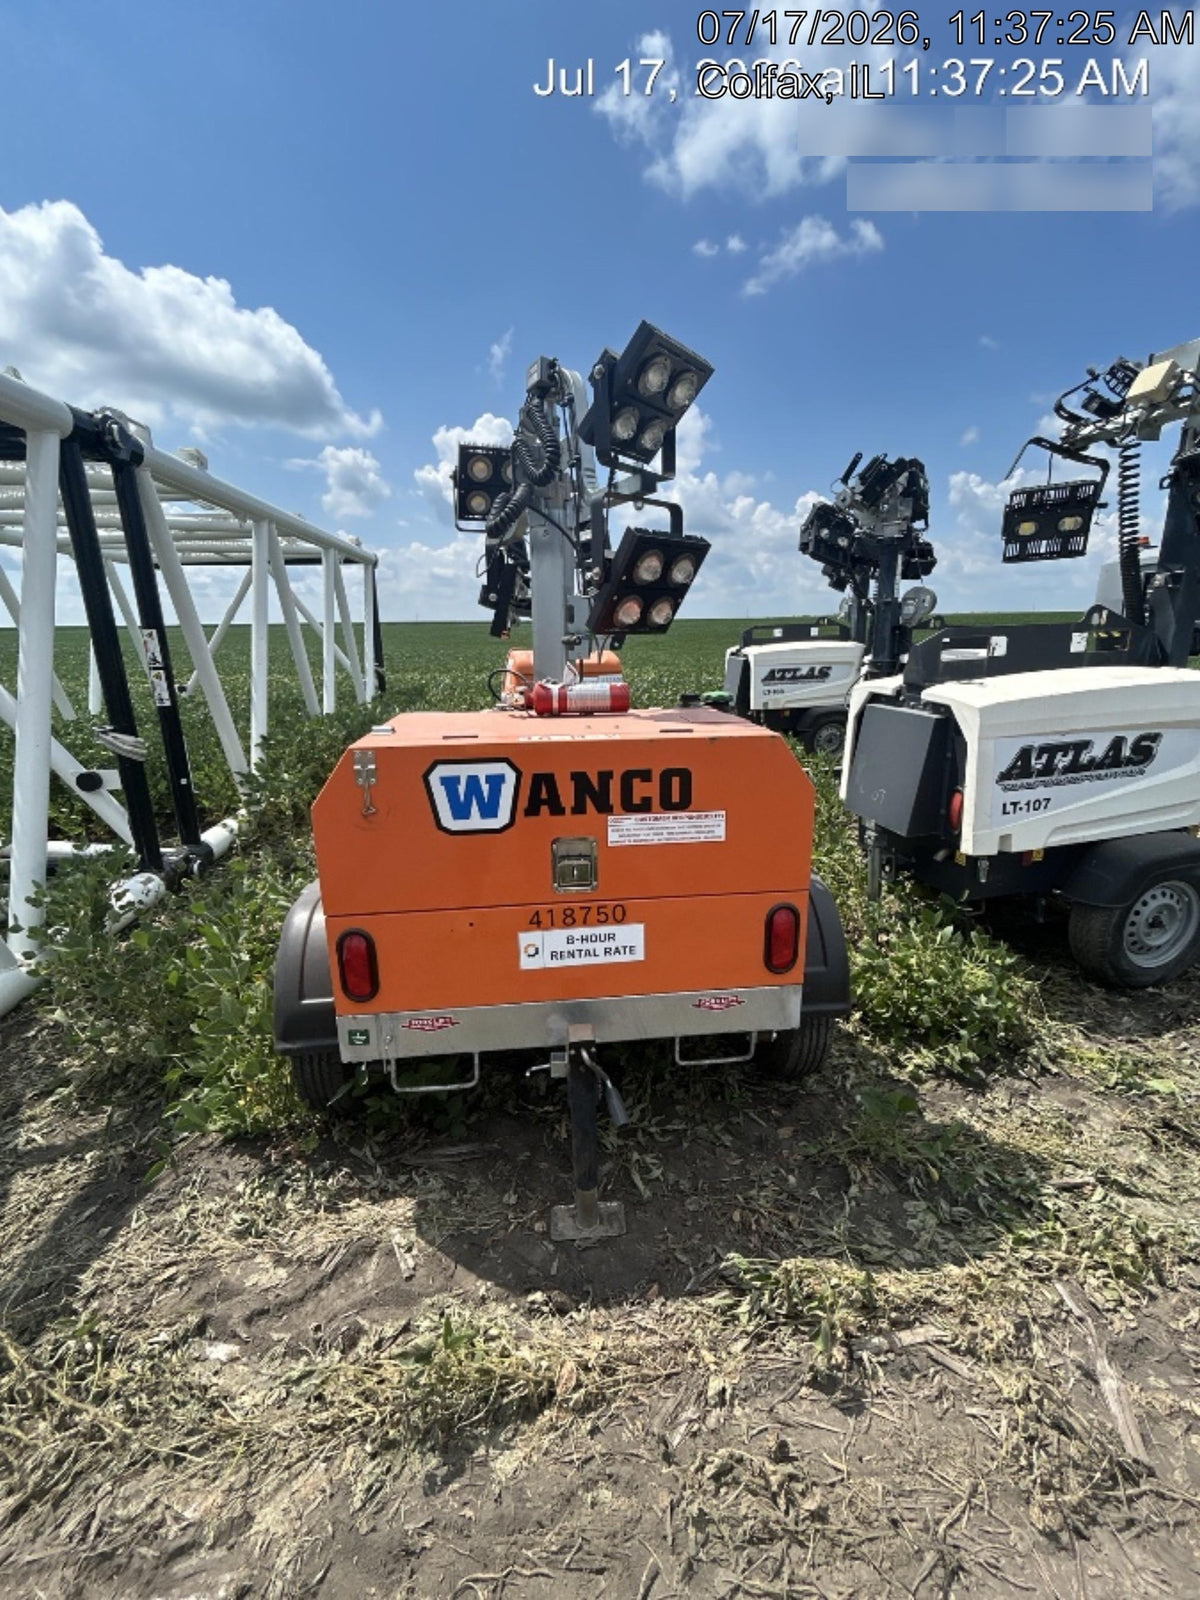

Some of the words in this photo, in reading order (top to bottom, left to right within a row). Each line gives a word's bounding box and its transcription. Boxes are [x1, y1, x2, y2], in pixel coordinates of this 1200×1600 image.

[761, 666, 832, 682] ATLAS
[996, 732, 1163, 784] ATLAS
[438, 767, 693, 821] WANCO
[1002, 798, 1052, 816] LT-107
[528, 904, 627, 929] 418750
[550, 948, 600, 961] RENTAL
[604, 944, 637, 957] RATE
